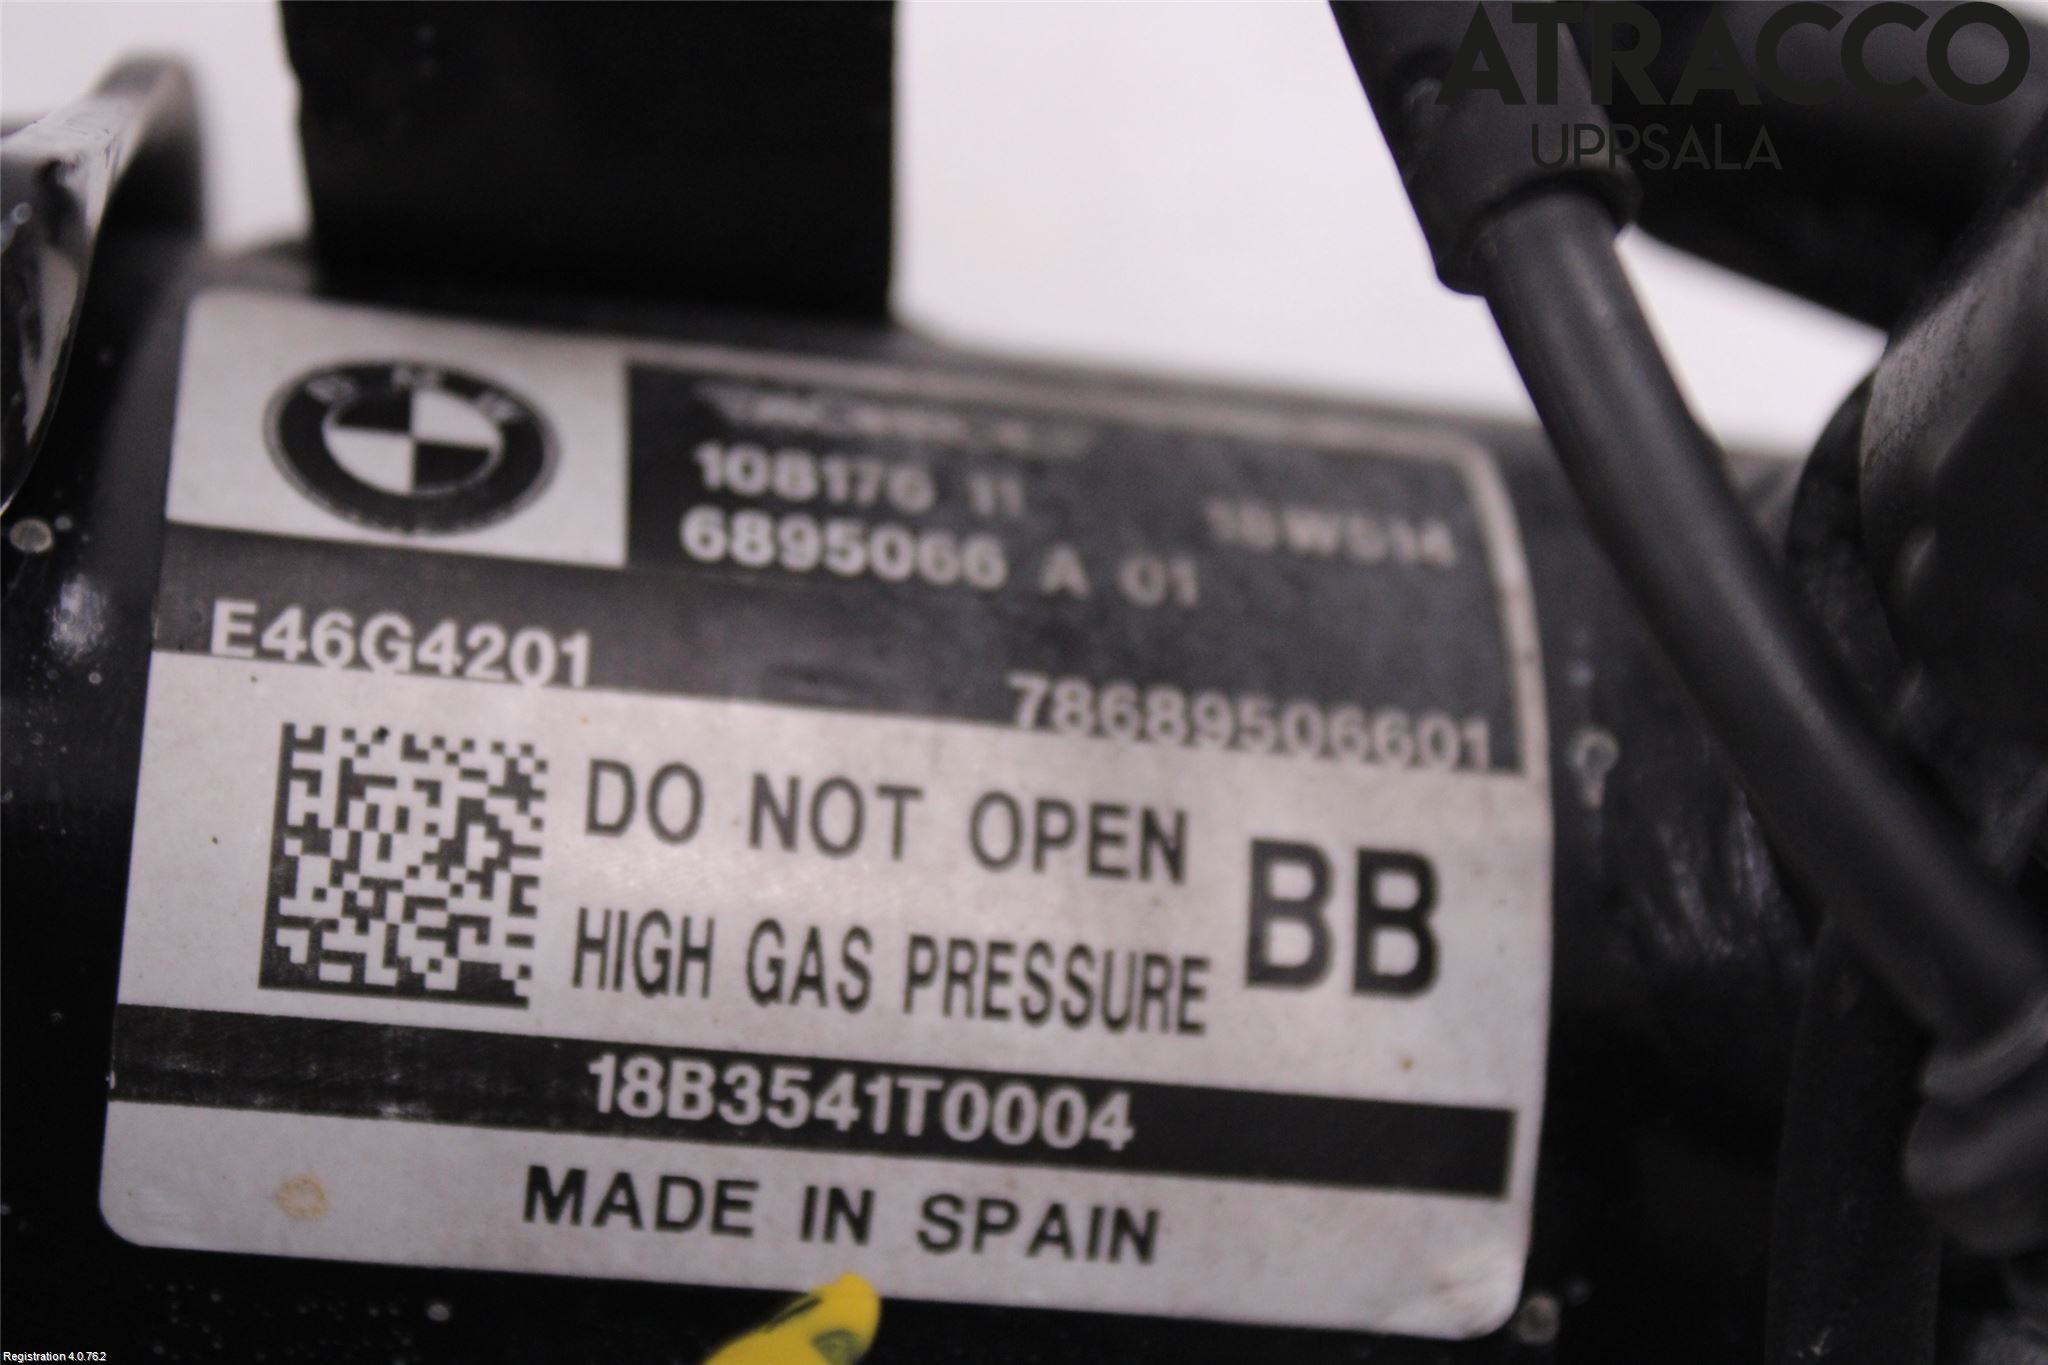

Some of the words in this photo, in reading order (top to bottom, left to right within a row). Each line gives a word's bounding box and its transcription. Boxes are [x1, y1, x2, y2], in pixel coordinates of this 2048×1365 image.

[680, 504, 1009, 590] 6895066
[1039, 541, 1091, 597] A
[1119, 550, 1200, 608] 01
[210, 600, 592, 688] E46G4201
[1008, 672, 1493, 770] 78689506601
[585, 758, 704, 845] DO
[748, 772, 923, 860] NOT
[968, 790, 1190, 885] OPEN
[1244, 836, 1442, 999] BB
[572, 906, 715, 1000] HIGH
[746, 918, 874, 1014] GAS
[904, 934, 1211, 1037] PRESSURE
[586, 1053, 1135, 1152] 18B3541T0004
[523, 1164, 759, 1239] MADE
[799, 1184, 876, 1246] IN
[916, 1193, 1161, 1266] SPAIN
